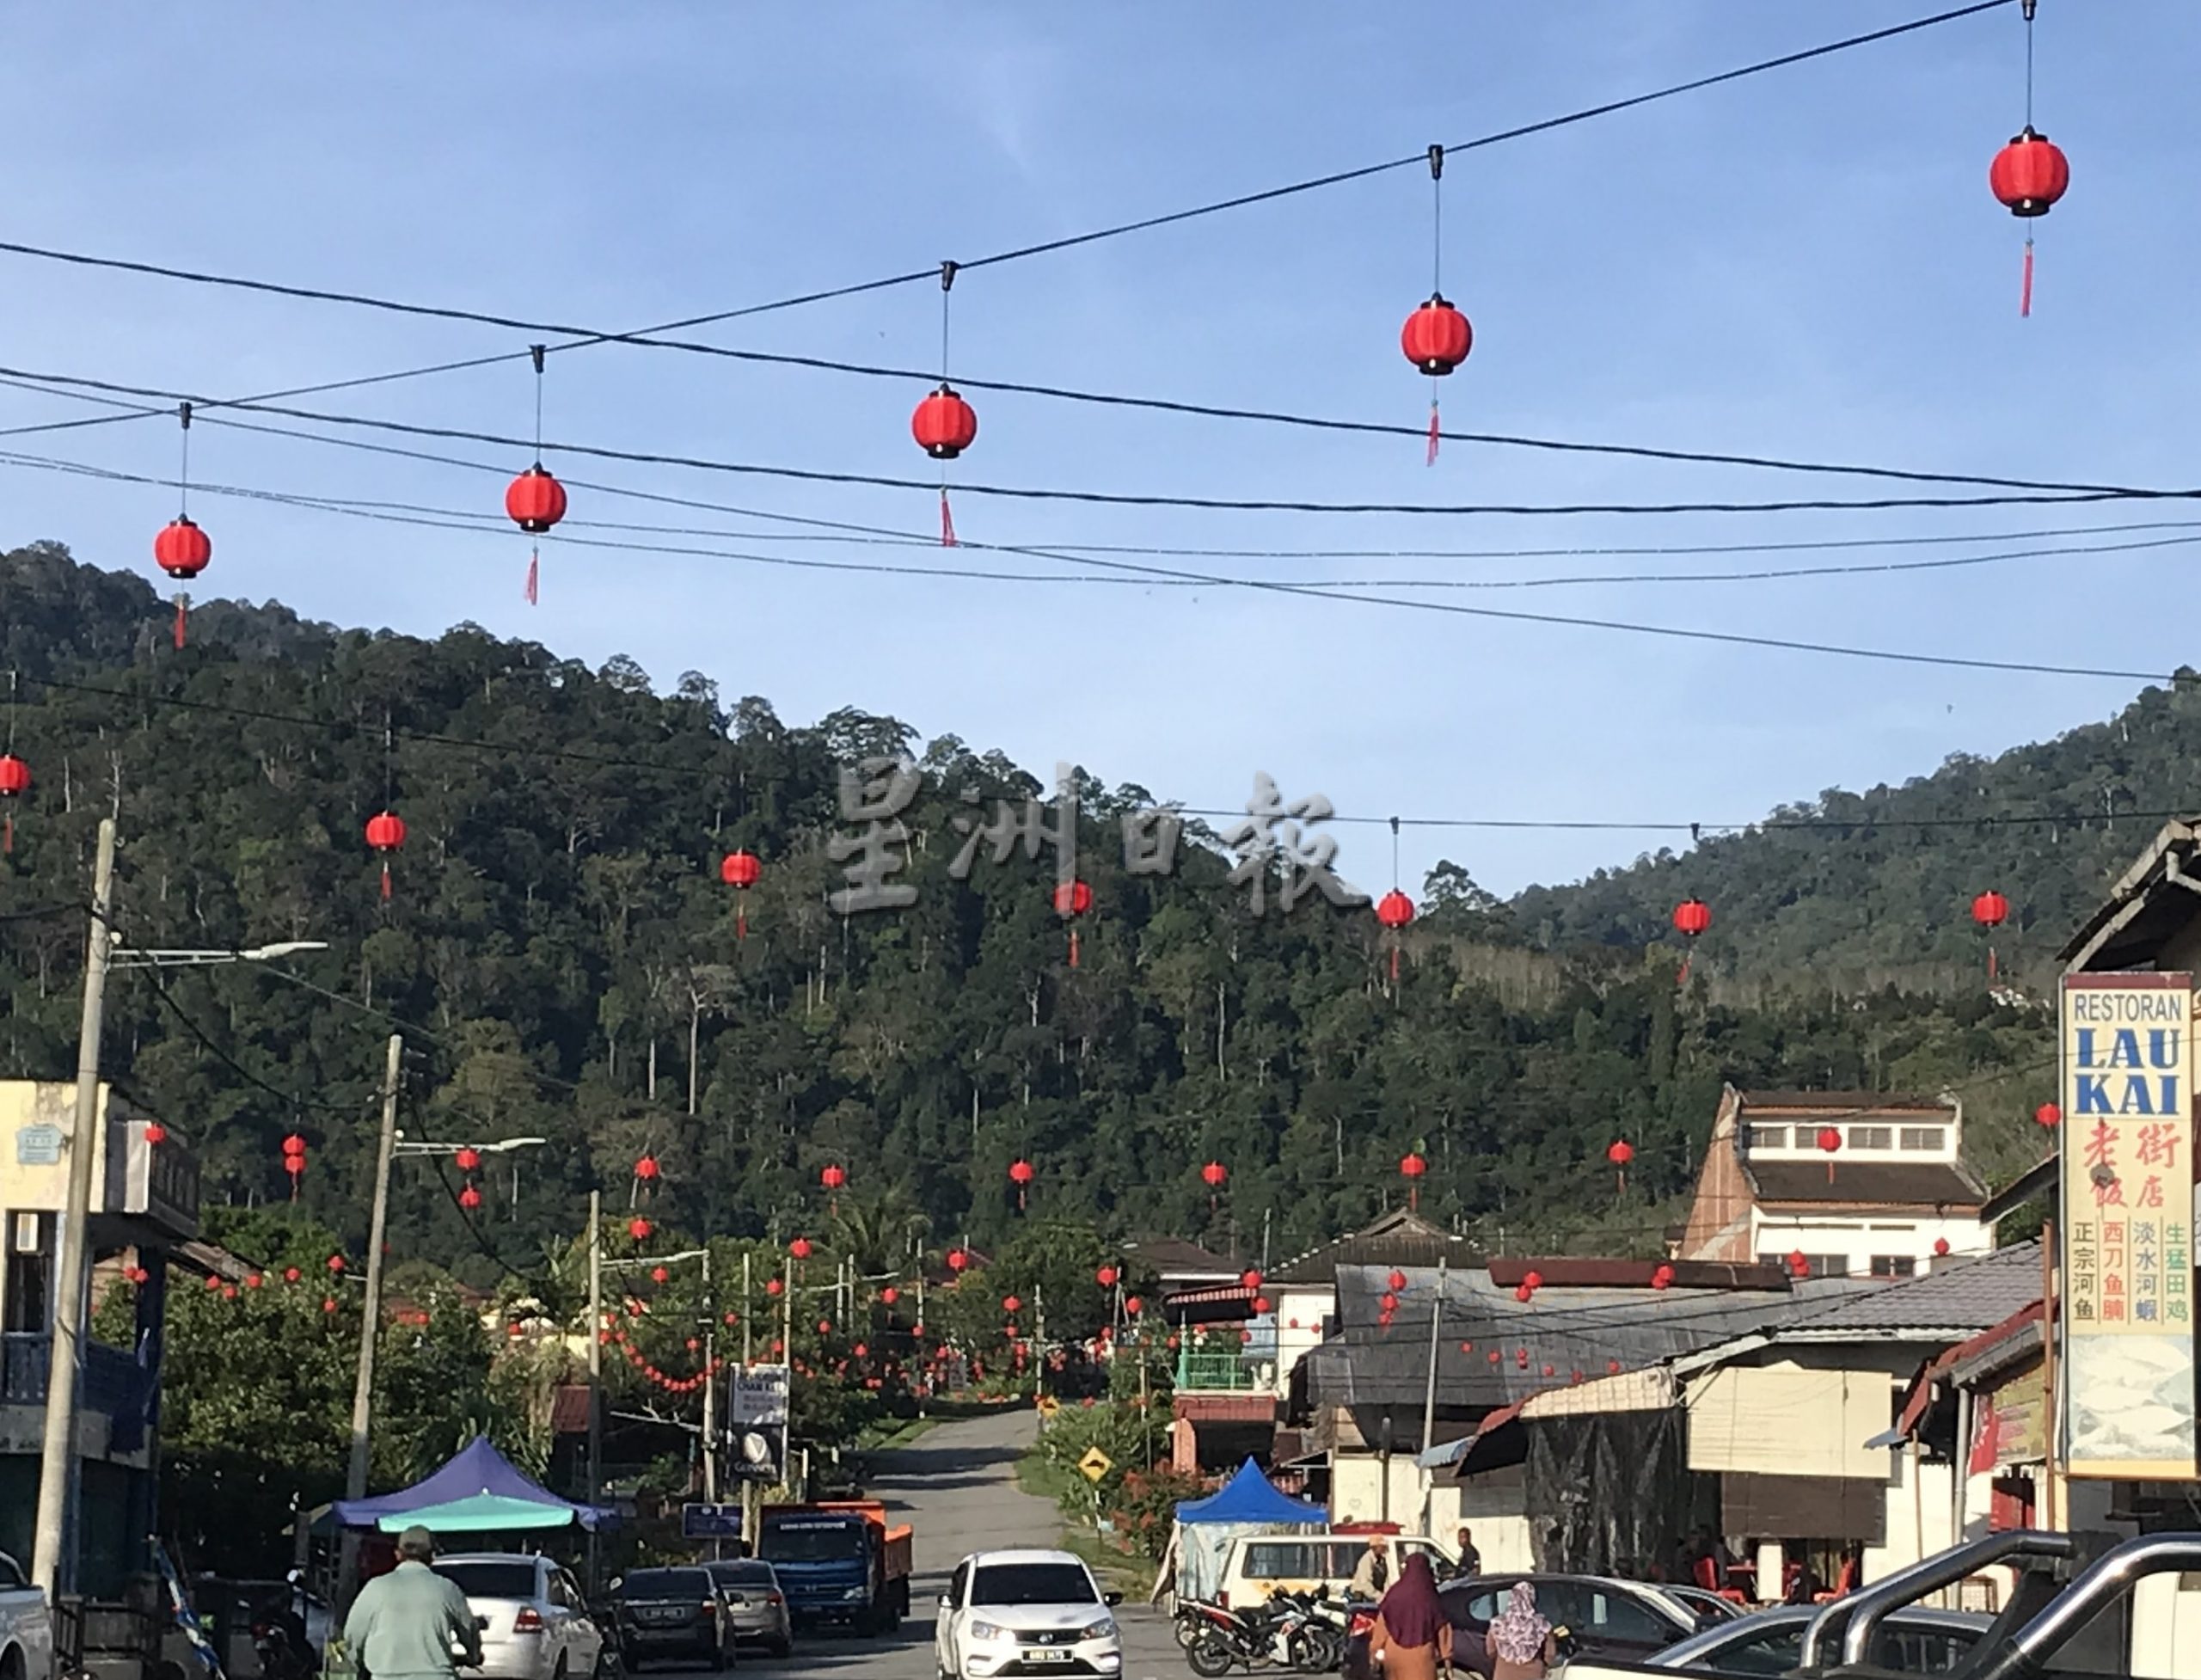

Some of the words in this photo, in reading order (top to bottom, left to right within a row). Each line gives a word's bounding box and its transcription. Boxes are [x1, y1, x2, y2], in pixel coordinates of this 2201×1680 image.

[2074, 993, 2182, 1021] RESTORAN
[2074, 1028, 2181, 1069] LAU
[2074, 1074, 2180, 1115] KAI
[2083, 1121, 2183, 1168] 老街
[2072, 1221, 2096, 1321] 正宗河鱼
[2165, 1221, 2189, 1322] 生猛田鸡
